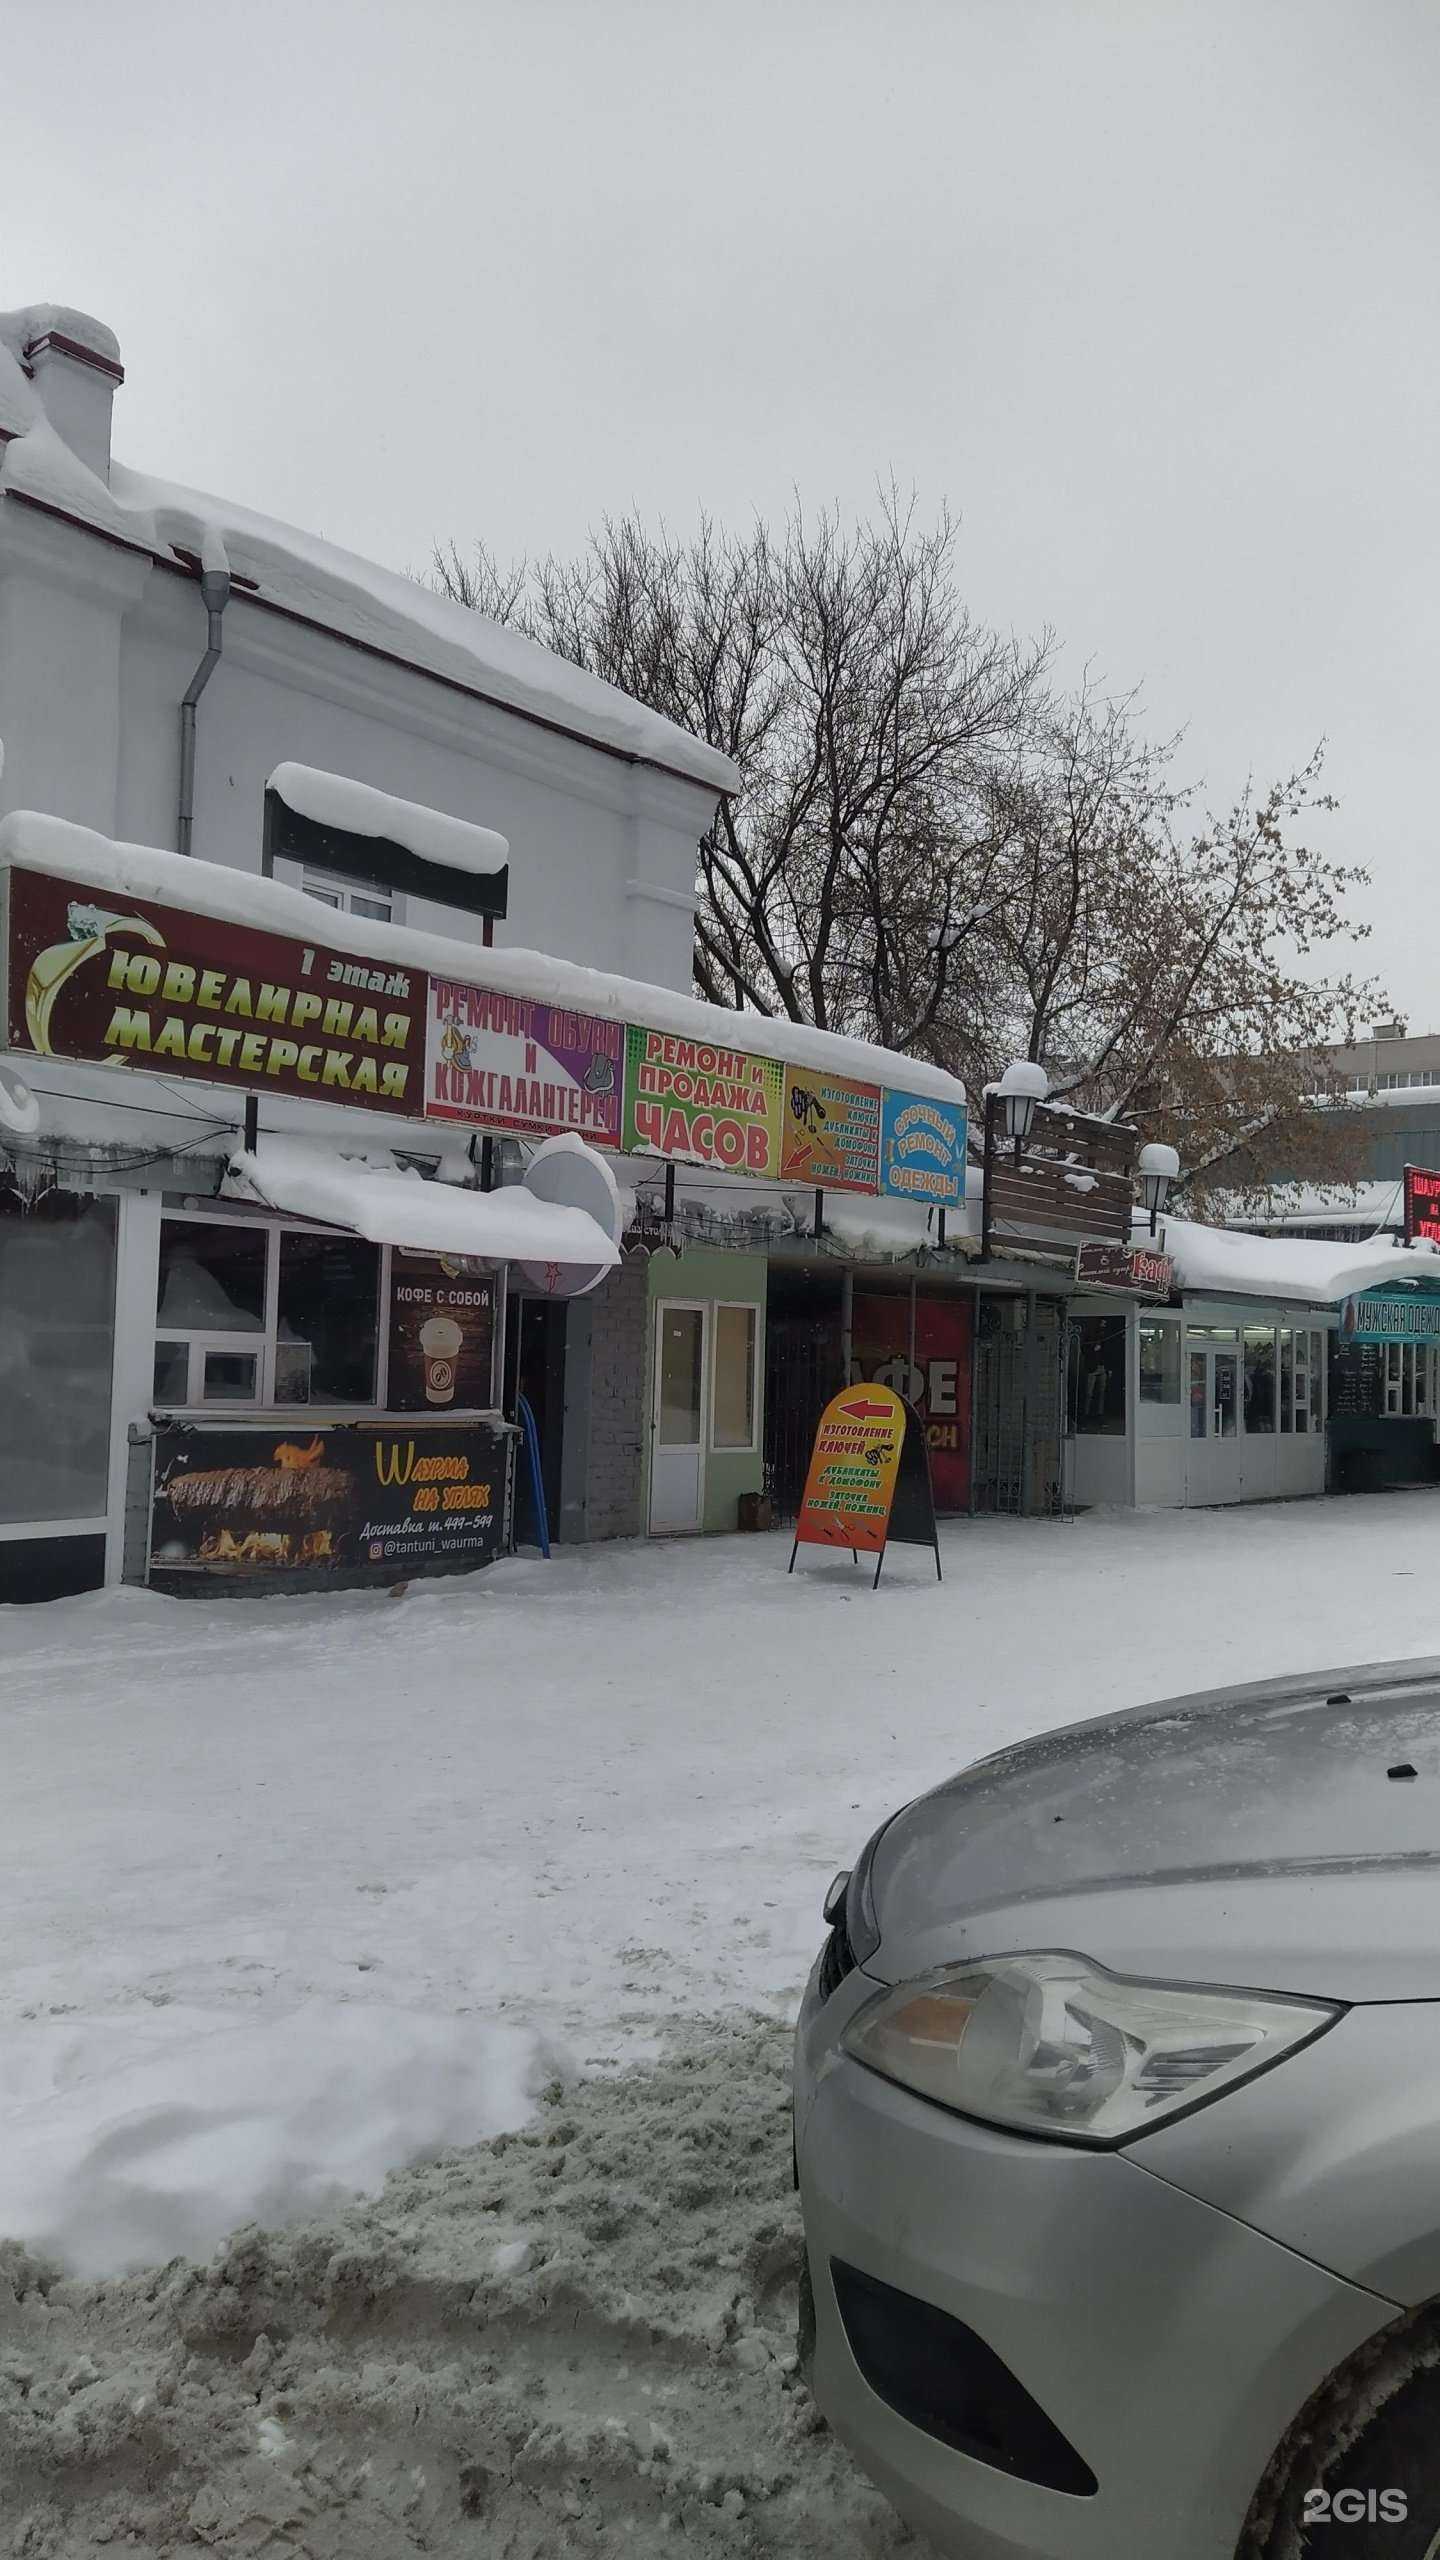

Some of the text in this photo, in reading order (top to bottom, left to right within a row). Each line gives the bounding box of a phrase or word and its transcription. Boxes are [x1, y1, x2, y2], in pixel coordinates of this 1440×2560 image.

[300, 948, 411, 999] 1 этаж
[107, 949, 411, 1049] ЮВЕЛИРНАЯ
[435, 982, 619, 1060] РЕМОНТ ОБУВИ
[103, 1007, 410, 1098] МАСТЕРСКАЯ
[646, 1032, 747, 1081] РЕМОНТ
[639, 1063, 768, 1117] ПРОДАЖА
[819, 1087, 878, 1111] ИЗГОТОВЛЕНИЕ
[456, 1109, 505, 1126] КУРТКИ
[512, 1119, 552, 1134] СУМКИ
[823, 1120, 870, 1140] ДУБЛИКАТЫ
[847, 1109, 878, 1127] КЛЮЧЕЙ
[894, 1104, 956, 1148] СРОЧНЫЙ
[635, 1101, 769, 1170] ЧАСОВ
[832, 1137, 878, 1156] ДОМОФОНУ
[898, 1132, 952, 1167] РЕМОНТ
[845, 1154, 877, 1171] ЗАТОЧКА
[889, 1165, 958, 1198] ОДЕЖДЫ
[396, 1286, 489, 1307] КОФЕ С СОБОЙ
[1356, 1301, 1406, 1332] МУЖСКАЯ
[823, 1424, 895, 1439] ИЗГОТОВЛЕНИЕ
[817, 1440, 866, 1455] КЛЮЧЕЙ
[823, 1465, 880, 1478] ДУБЛИКАТЫ
[829, 1476, 882, 1489] ДОМОФОНУ
[413, 1484, 491, 1511] НА УГЛЯХ
[829, 1490, 868, 1503] ЗАТОЧКА
[360, 1517, 425, 1541] Доставка
[384, 1536, 483, 1556] @tantuni_waurma
